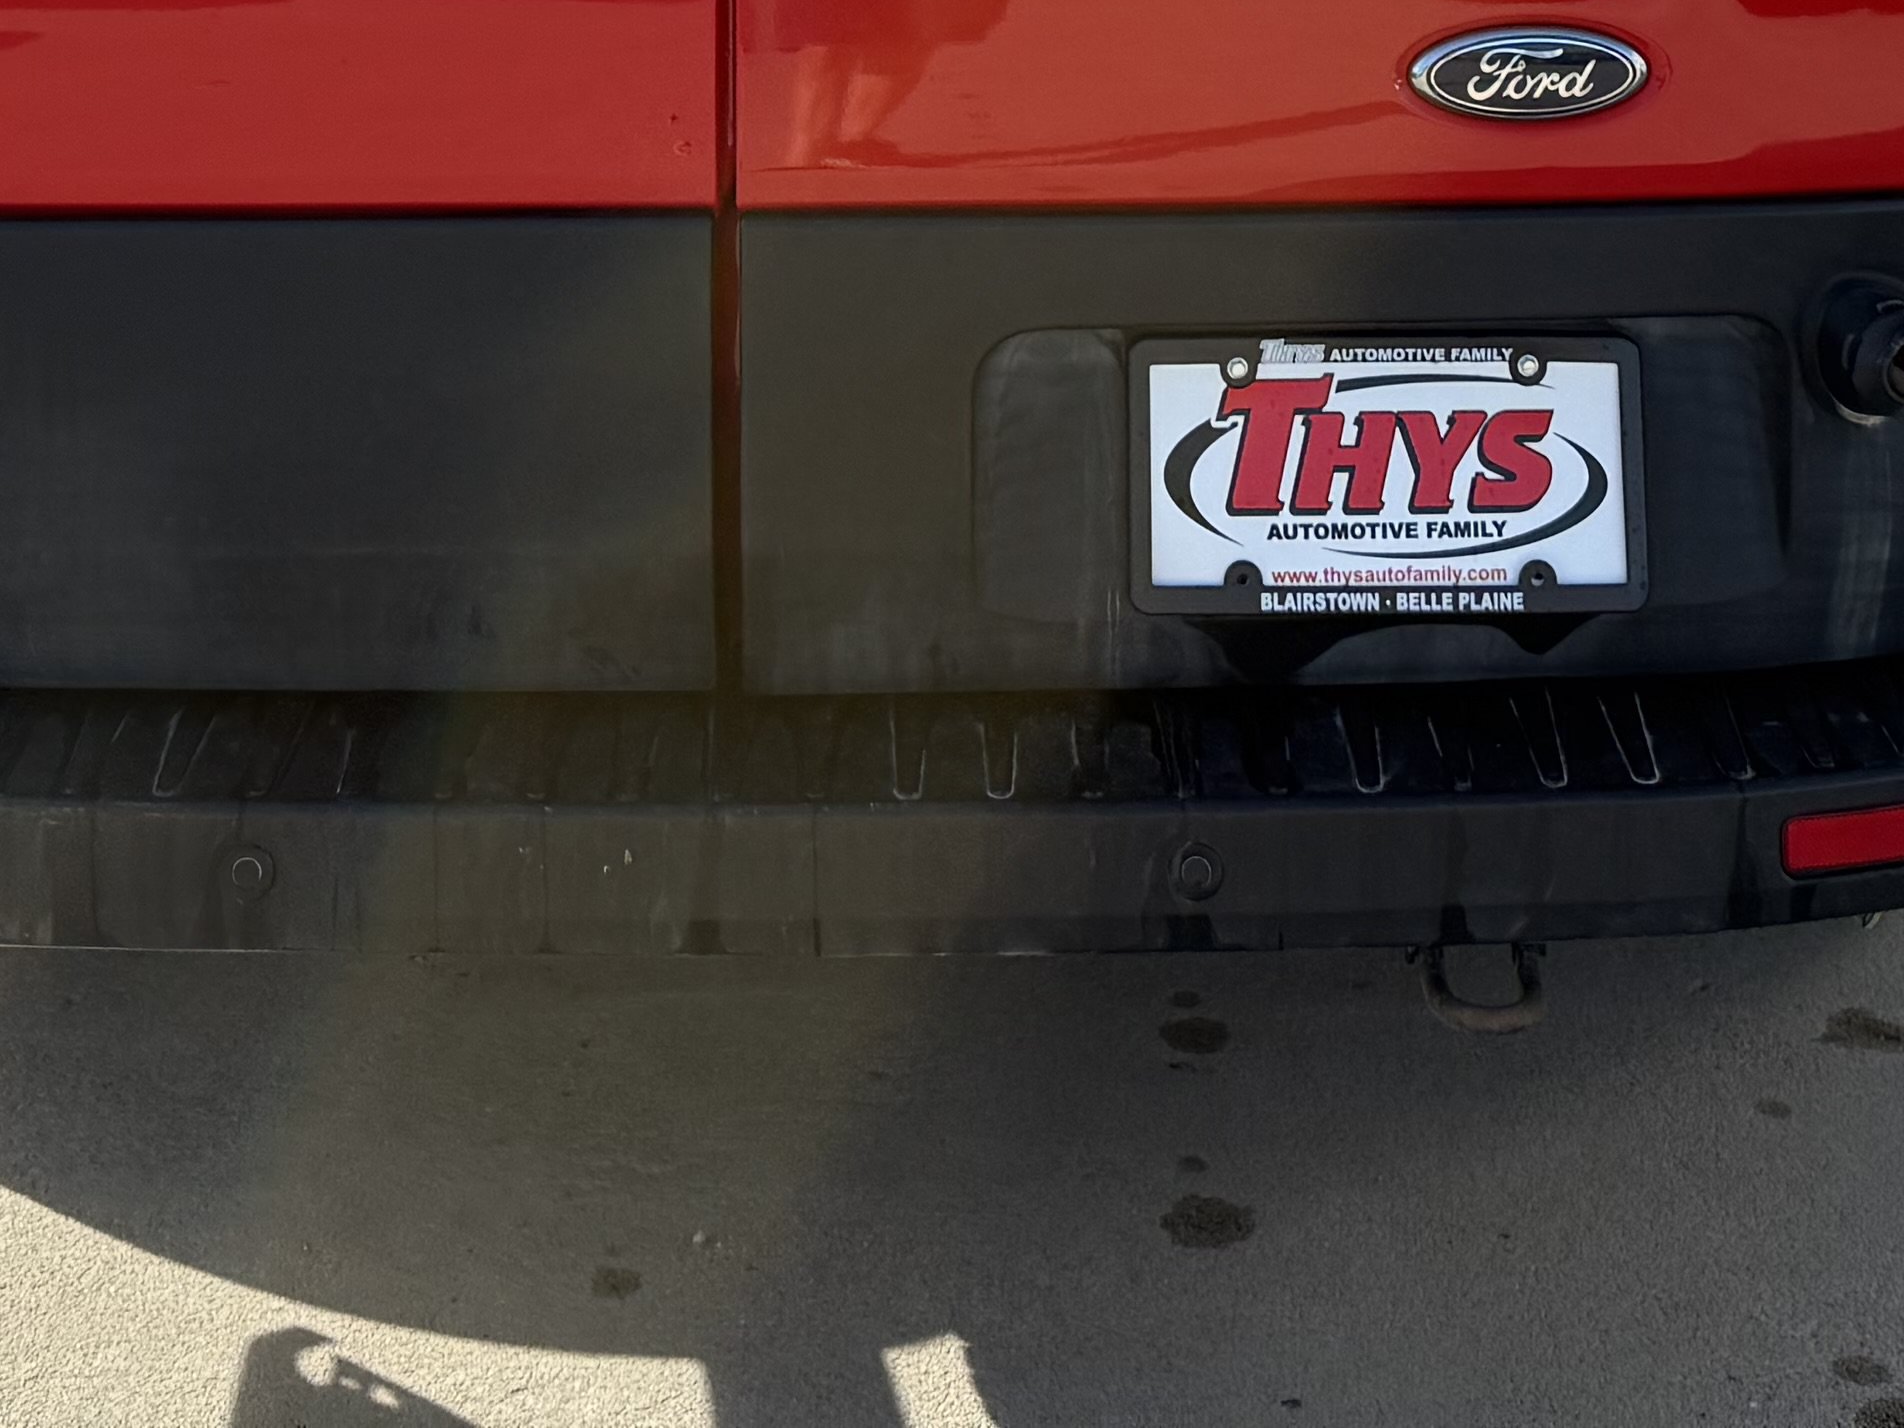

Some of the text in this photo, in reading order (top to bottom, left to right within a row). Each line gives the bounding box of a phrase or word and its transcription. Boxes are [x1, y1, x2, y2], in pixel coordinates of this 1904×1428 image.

[1466, 48, 1596, 102] Ford
[1329, 348, 1445, 363] AUTOMOTIVE
[1450, 347, 1514, 362] FAMILY
[1215, 372, 1555, 517] THYS
[1266, 519, 1508, 541] AUTOMOTIVE FAMILY
[1271, 565, 1509, 587] www.thysautofamily.com
[1260, 592, 1525, 612] BLAIRSTOWN BELLE PLAINE
